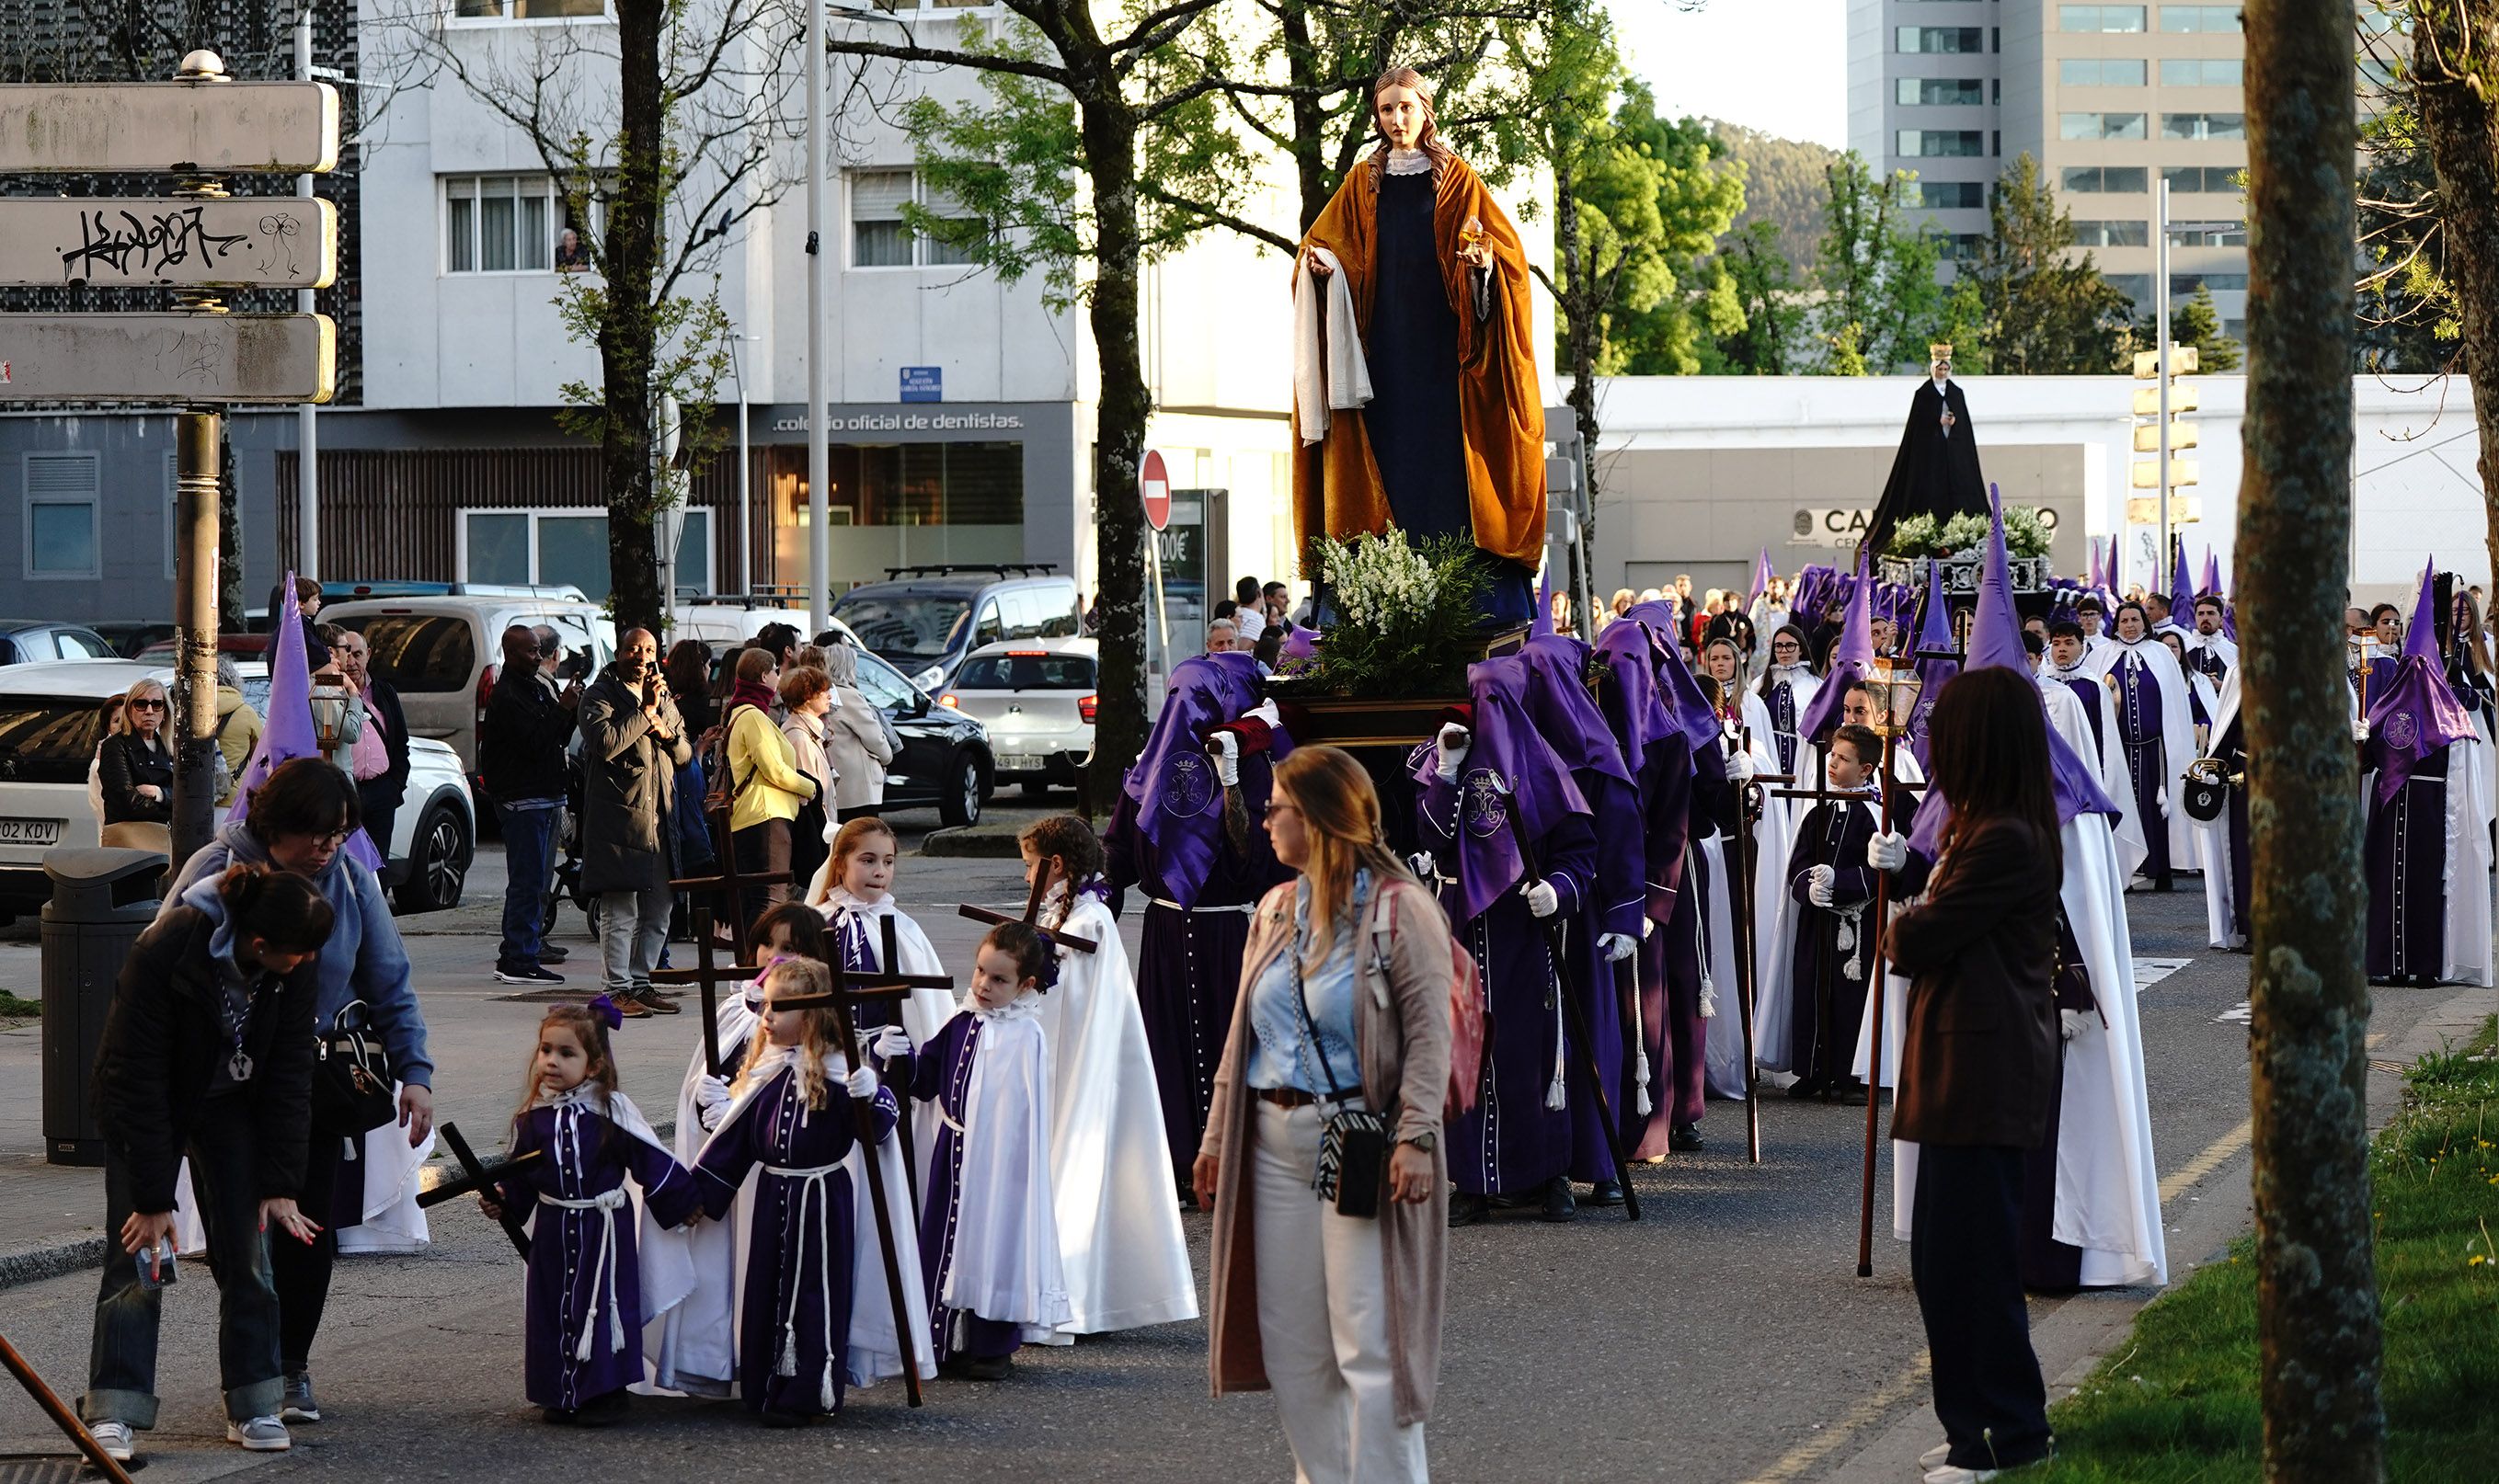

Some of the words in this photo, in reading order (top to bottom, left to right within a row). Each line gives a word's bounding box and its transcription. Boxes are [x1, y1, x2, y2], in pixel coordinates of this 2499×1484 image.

[773, 415, 843, 431] .coleio
[848, 414, 900, 430] oficial
[904, 414, 928, 429] de
[933, 412, 1024, 429] dentistas.
[0, 822, 20, 839] 02
[25, 823, 53, 839] KDV
